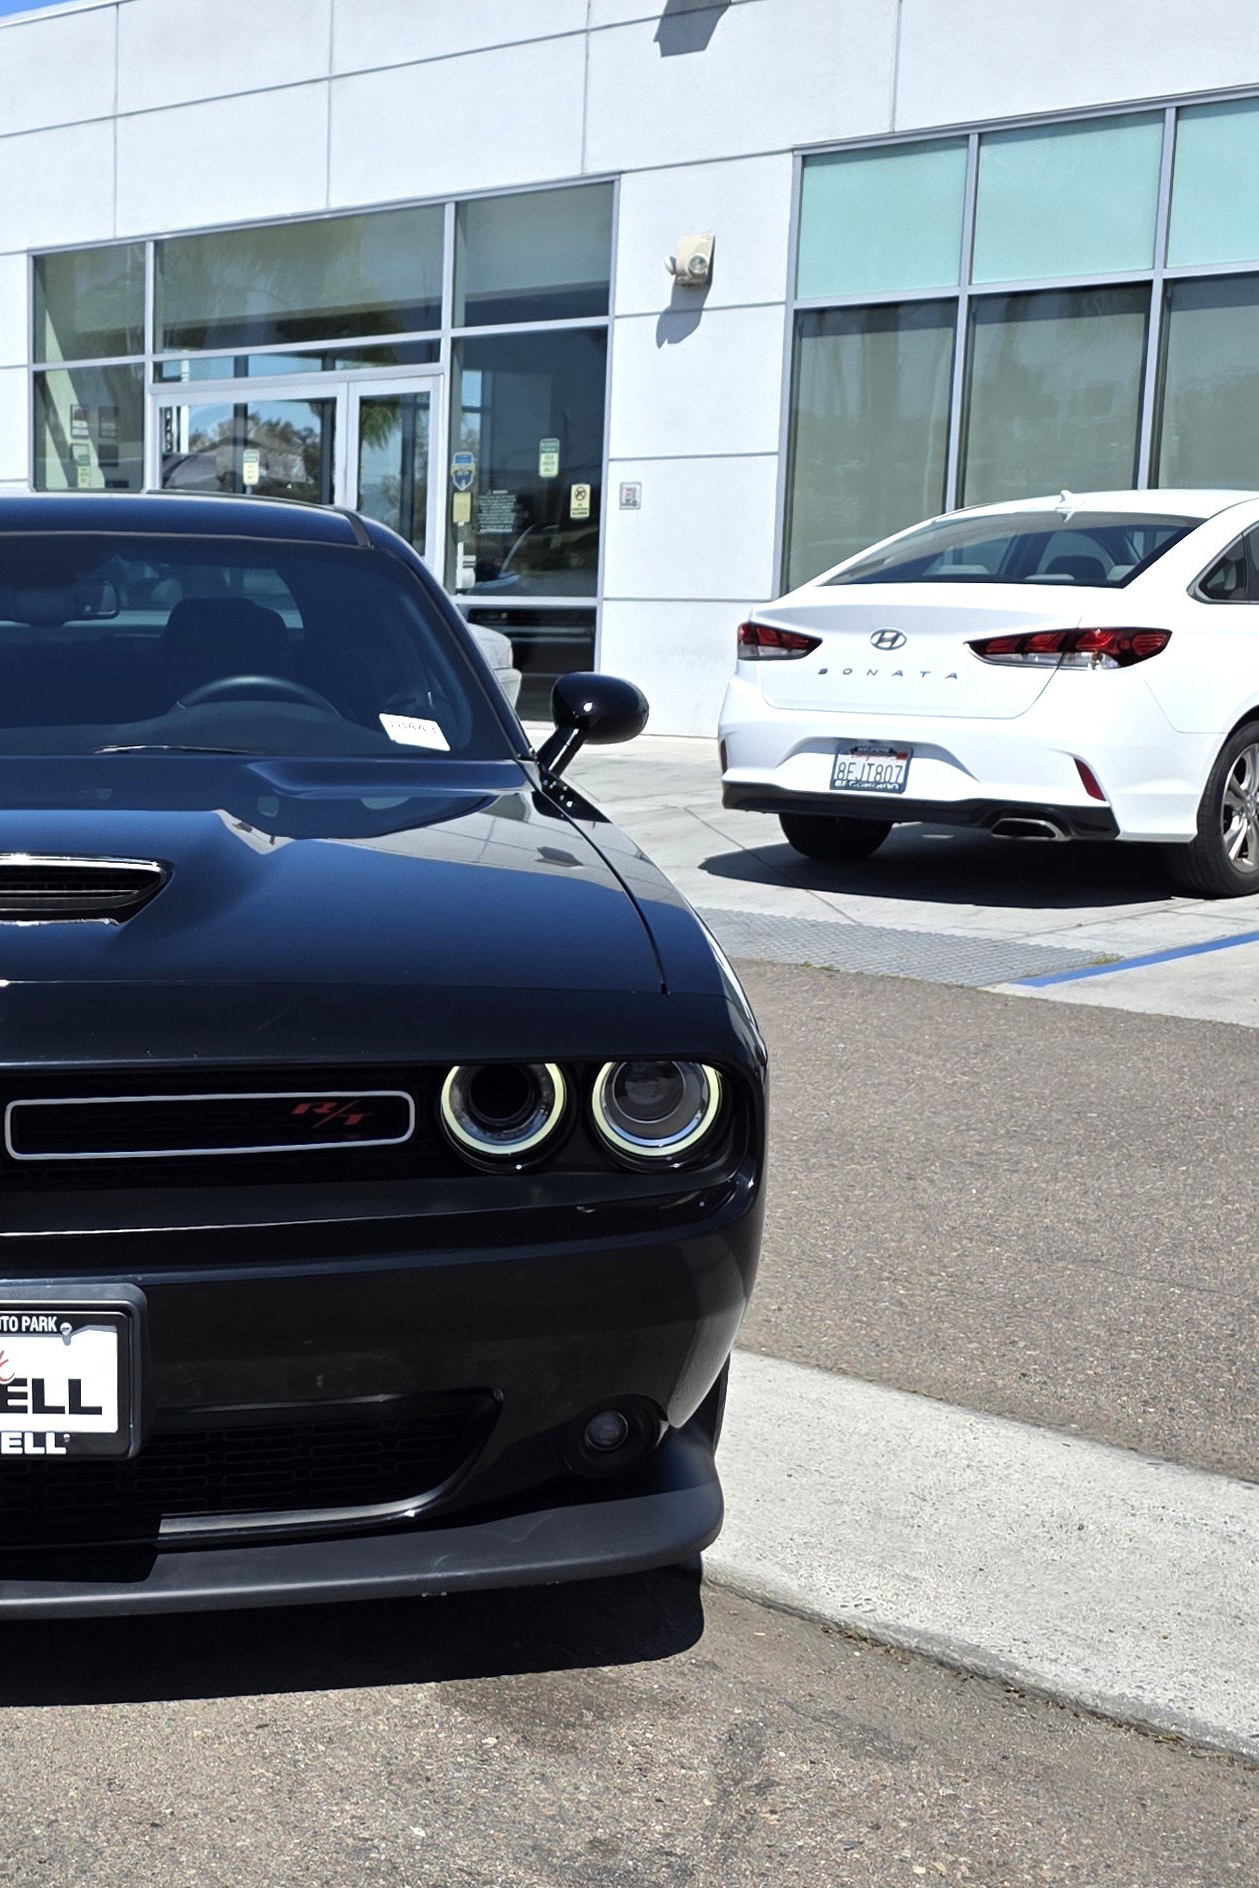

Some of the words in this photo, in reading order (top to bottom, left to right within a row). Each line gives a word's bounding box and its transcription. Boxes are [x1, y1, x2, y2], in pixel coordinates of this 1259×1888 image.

[817, 667, 958, 680] SONATA
[837, 761, 904, 783] 8EJT807
[289, 1100, 375, 1128] R/T
[21, 1315, 58, 1332] PARK
